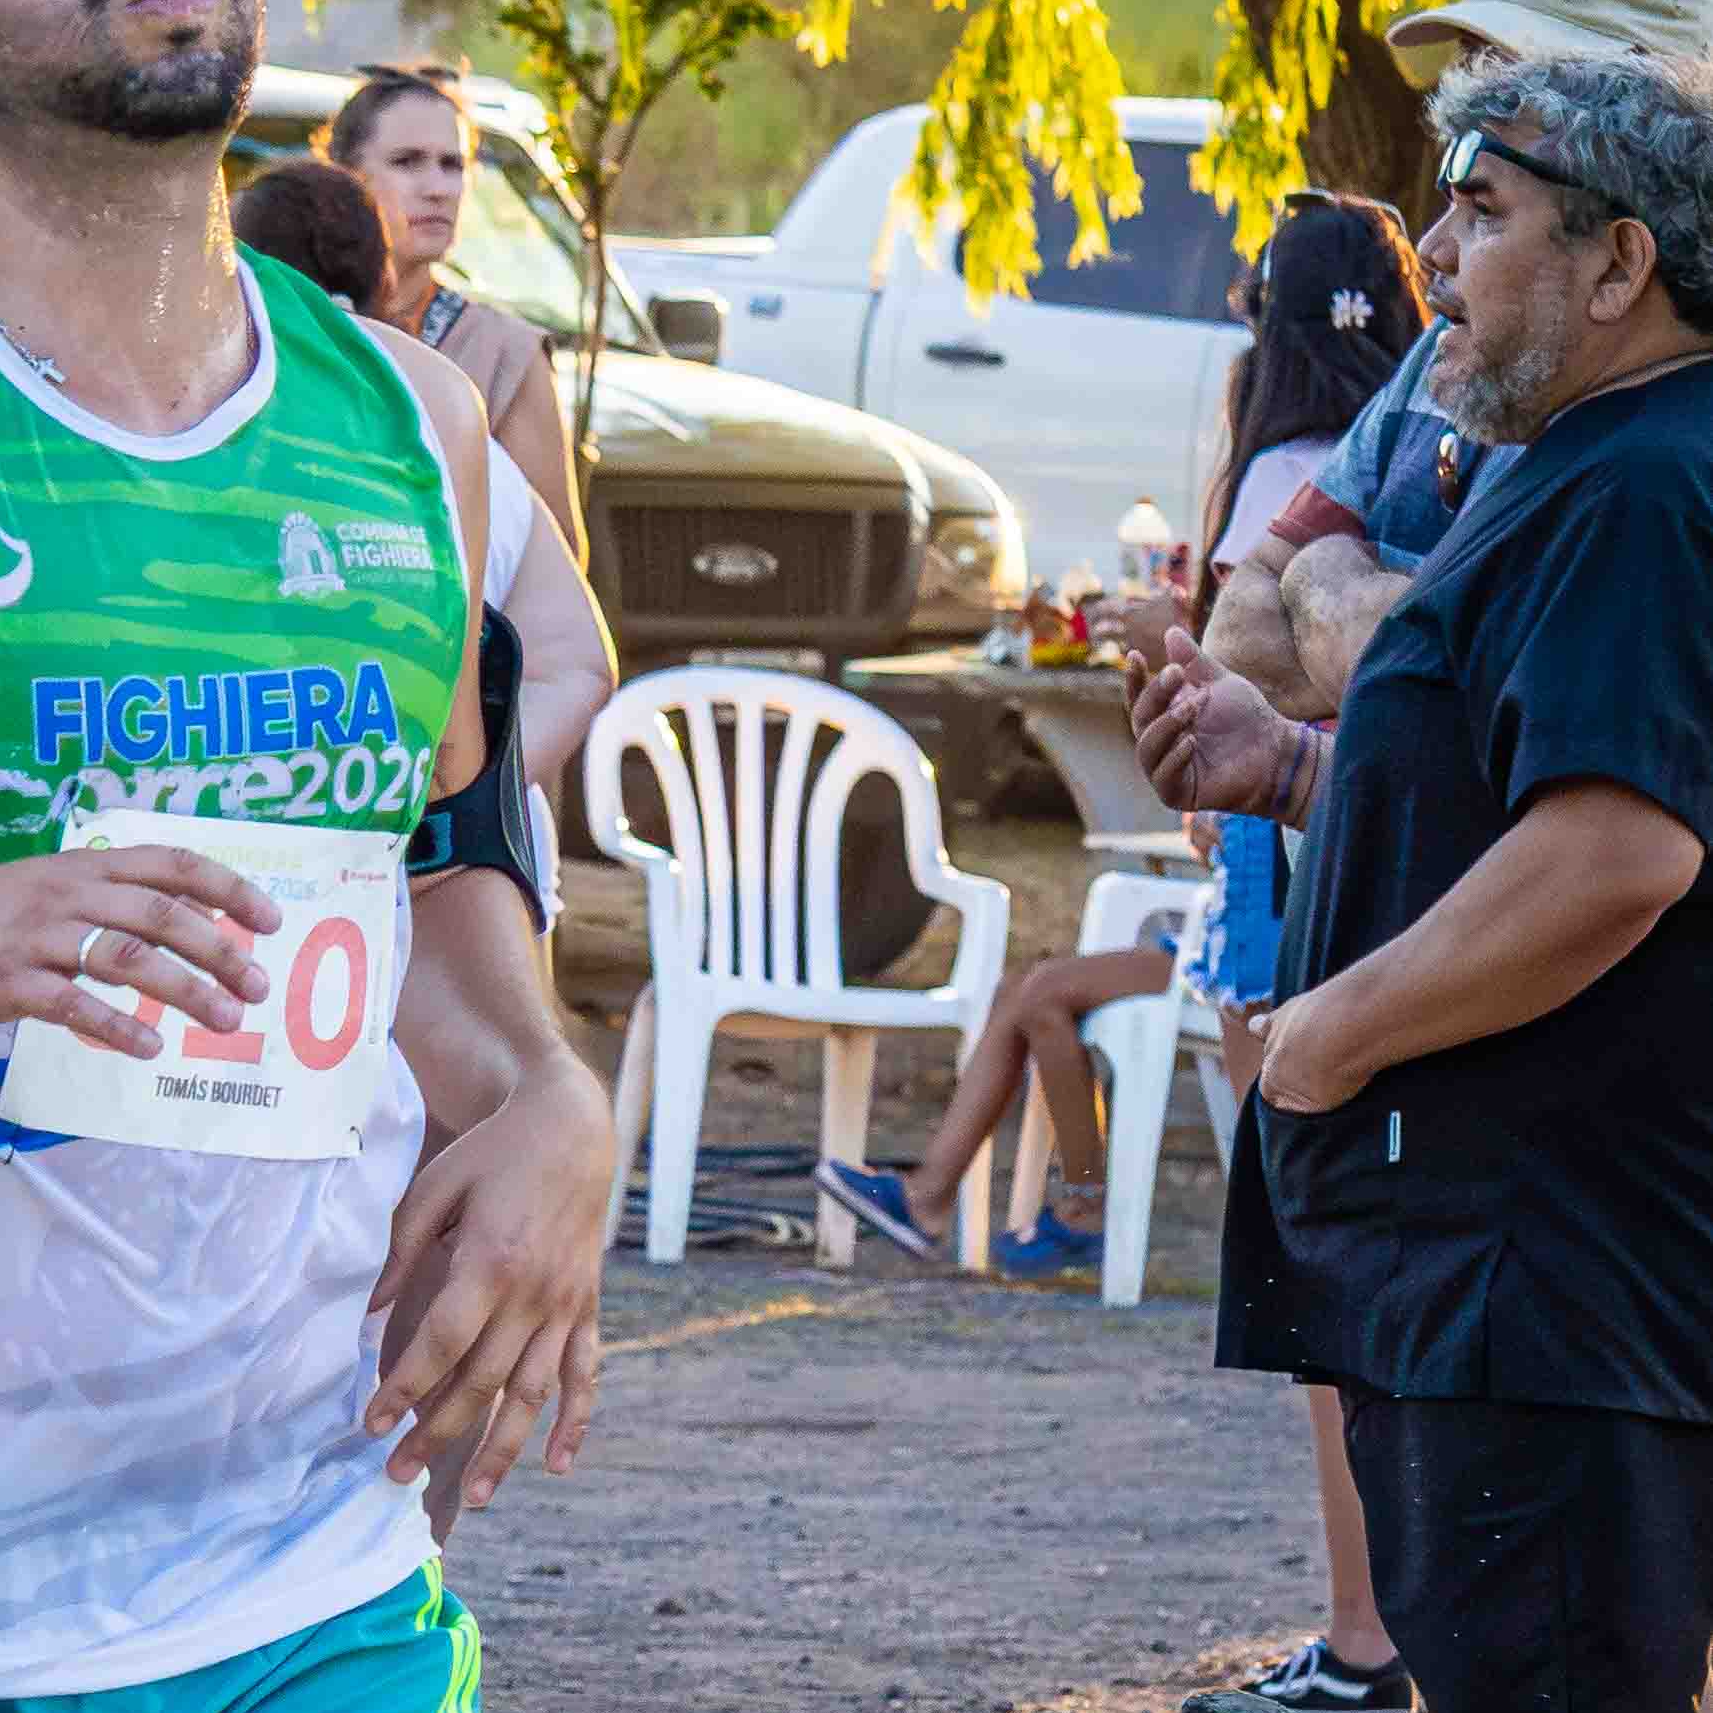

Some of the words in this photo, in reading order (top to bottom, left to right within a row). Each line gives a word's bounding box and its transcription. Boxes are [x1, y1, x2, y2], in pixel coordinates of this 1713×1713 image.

[336, 520, 403, 544] COMUNA
[341, 542, 435, 571] FIGHIERA
[31, 661, 402, 764] FIGHIERA
[155, 1075, 207, 1103] TOMÁS
[211, 1082, 283, 1109] BOURDET
